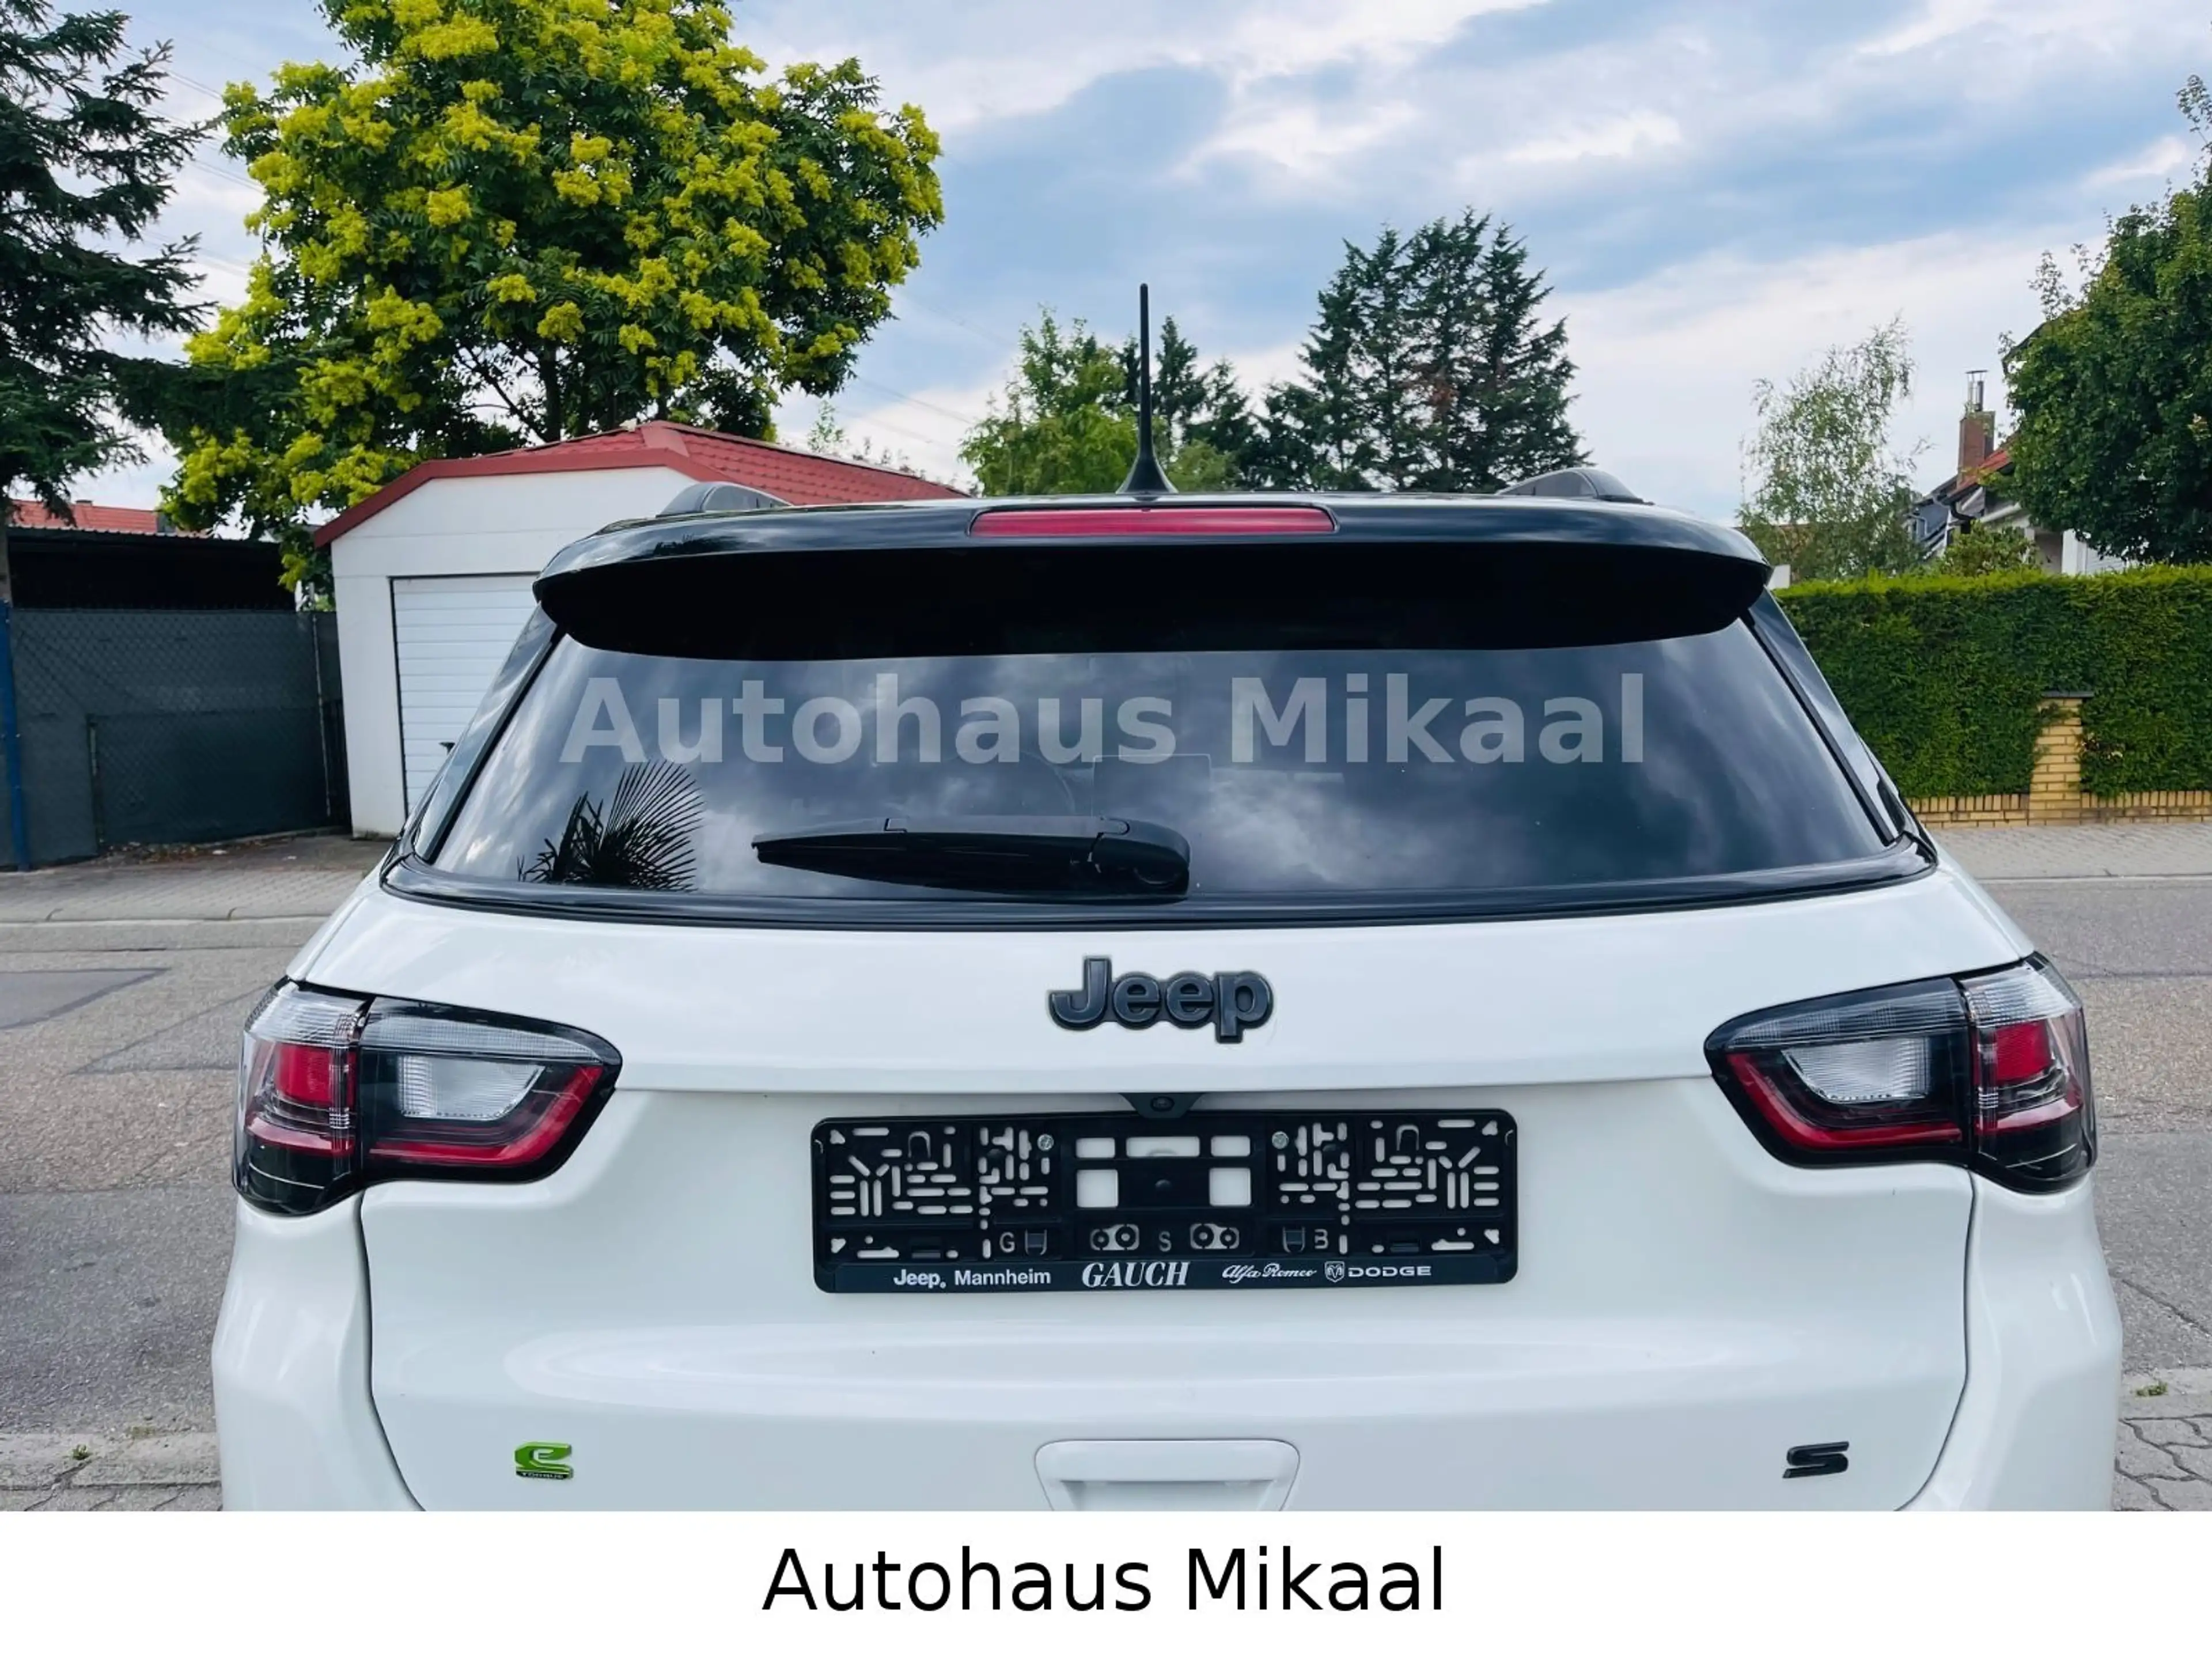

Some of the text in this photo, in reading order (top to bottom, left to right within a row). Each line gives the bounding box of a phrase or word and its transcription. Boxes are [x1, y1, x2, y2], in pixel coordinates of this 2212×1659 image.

[1049, 957, 1274, 1044] Jeep
[955, 1268, 1051, 1286] Mannheim
[1082, 1262, 1190, 1288] GAUCH
[1348, 1266, 1432, 1278] DODGE
[1782, 1441, 1850, 1479] S
